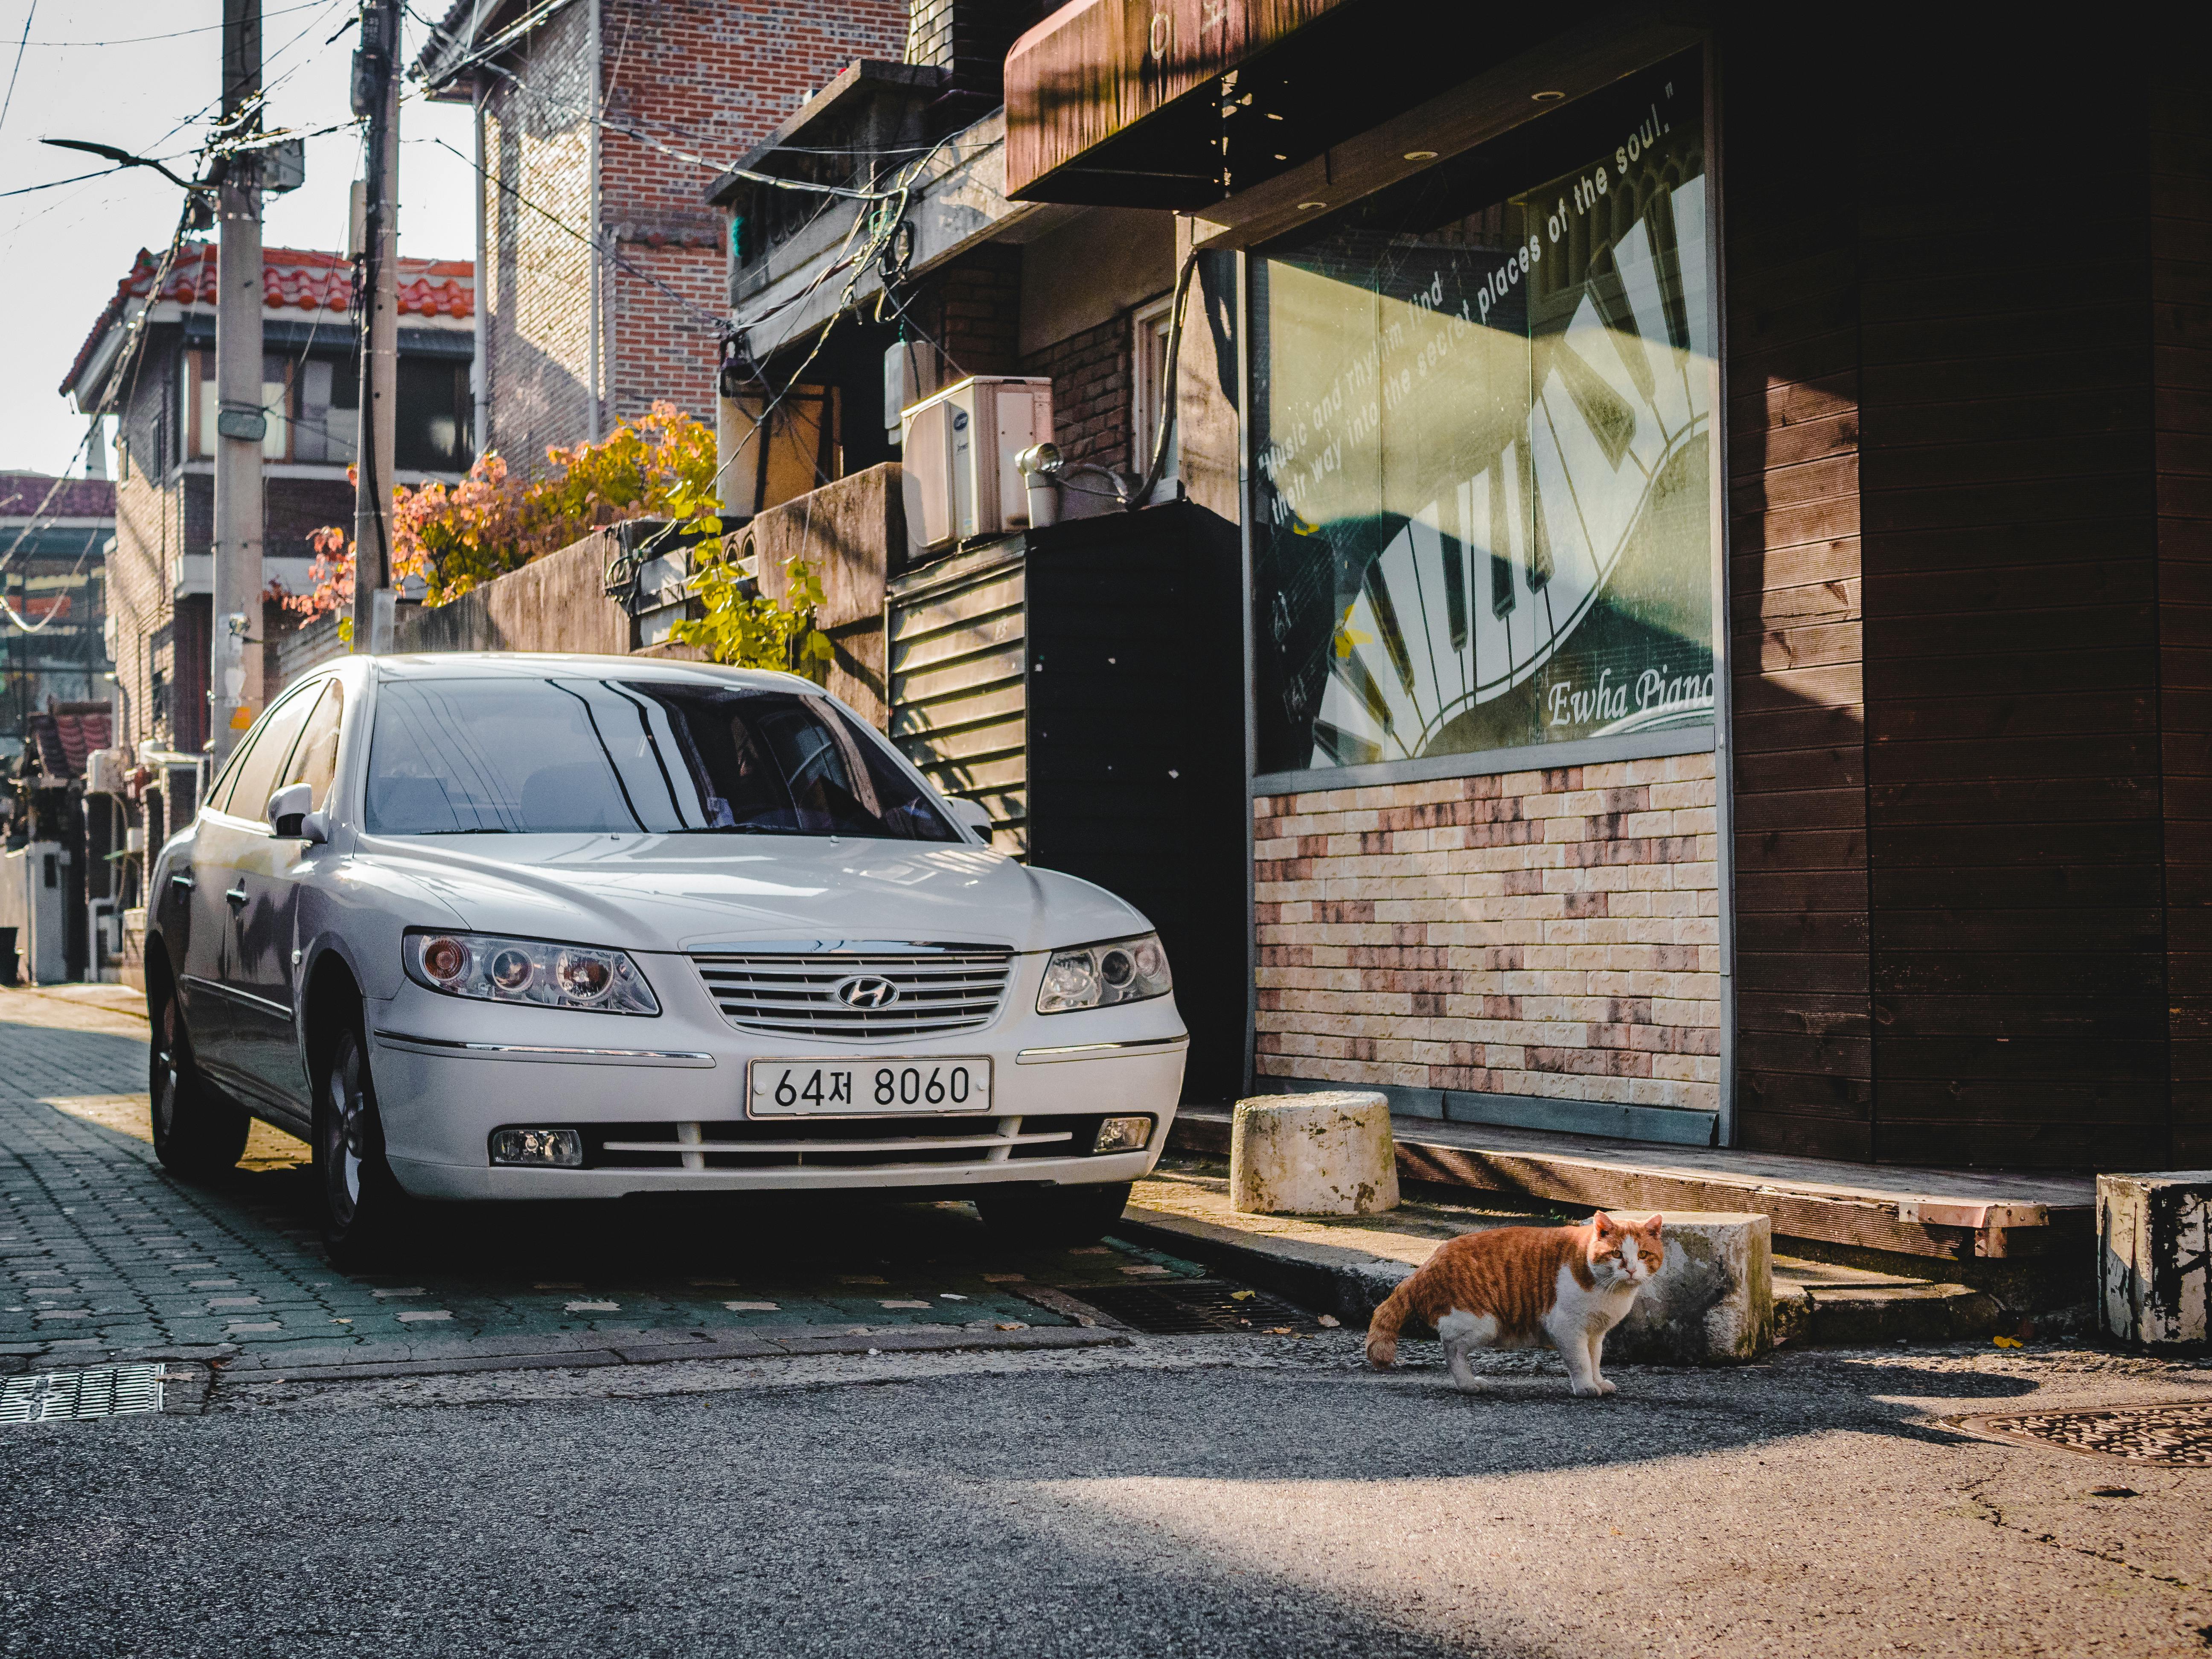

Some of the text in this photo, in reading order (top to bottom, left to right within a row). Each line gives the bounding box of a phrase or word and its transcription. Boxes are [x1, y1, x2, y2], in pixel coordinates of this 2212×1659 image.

[1272, 473, 1305, 525] their
[1310, 437, 1341, 483] way
[1347, 402, 1378, 448] into
[1383, 369, 1410, 410] the
[1417, 299, 1471, 377] secret
[1478, 235, 1541, 326] places
[1548, 198, 1567, 243] of
[1574, 167, 1607, 215] the
[1313, 378, 1342, 430] and
[1408, 271, 1443, 330] find
[1548, 664, 1714, 726] Ewha Piano
[775, 1066, 969, 1106] 64저 8060
